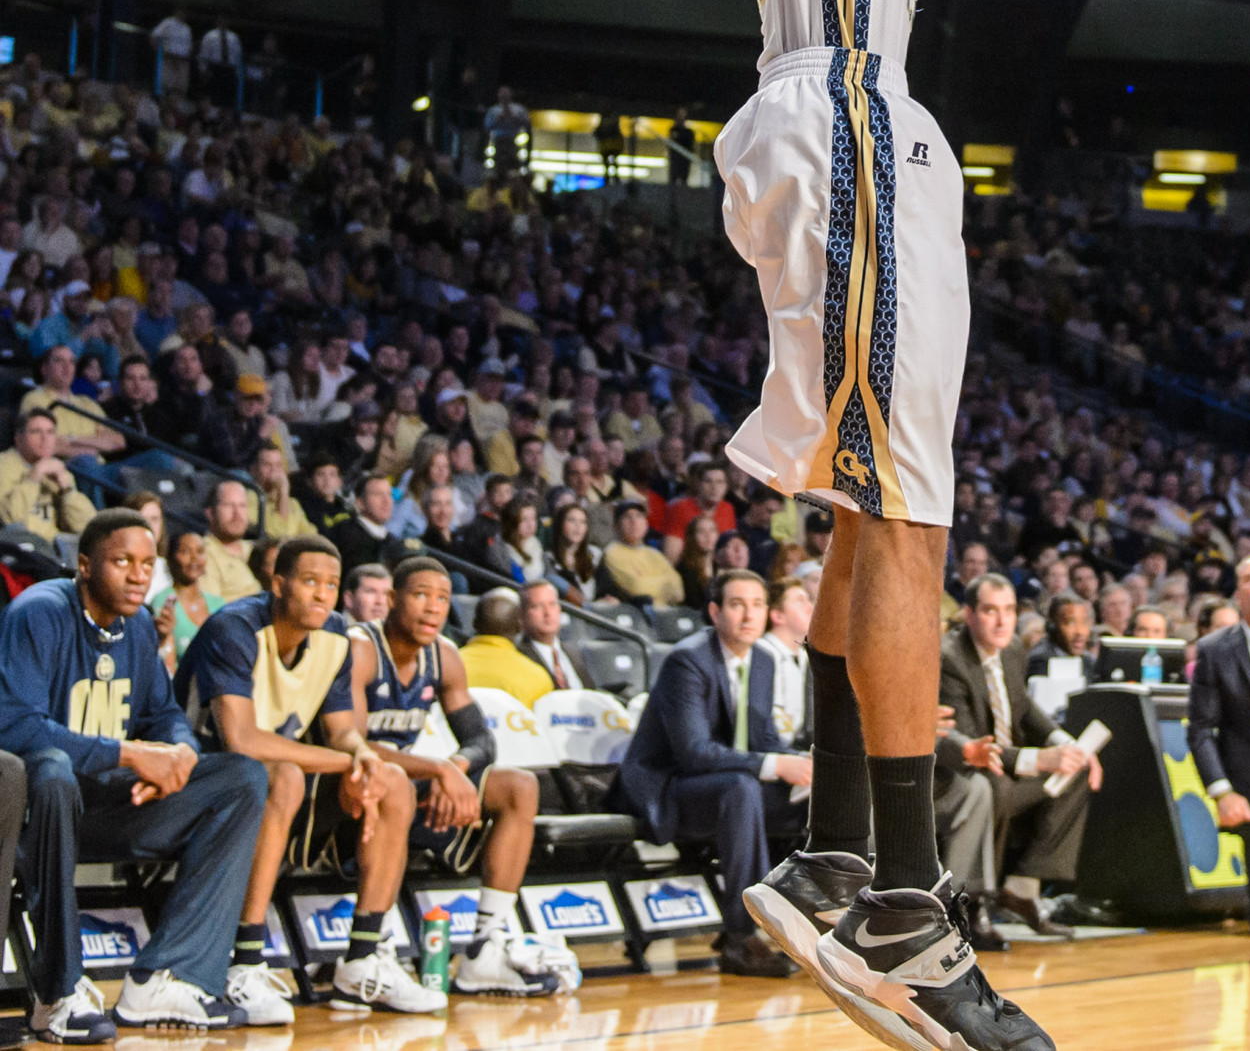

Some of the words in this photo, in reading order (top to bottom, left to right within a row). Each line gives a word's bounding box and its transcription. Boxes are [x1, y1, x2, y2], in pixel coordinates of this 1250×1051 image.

[912, 141, 929, 160] R
[68, 677, 131, 741] ONE
[543, 901, 604, 928] LOWE'S
[649, 894, 704, 922] LOWE'S
